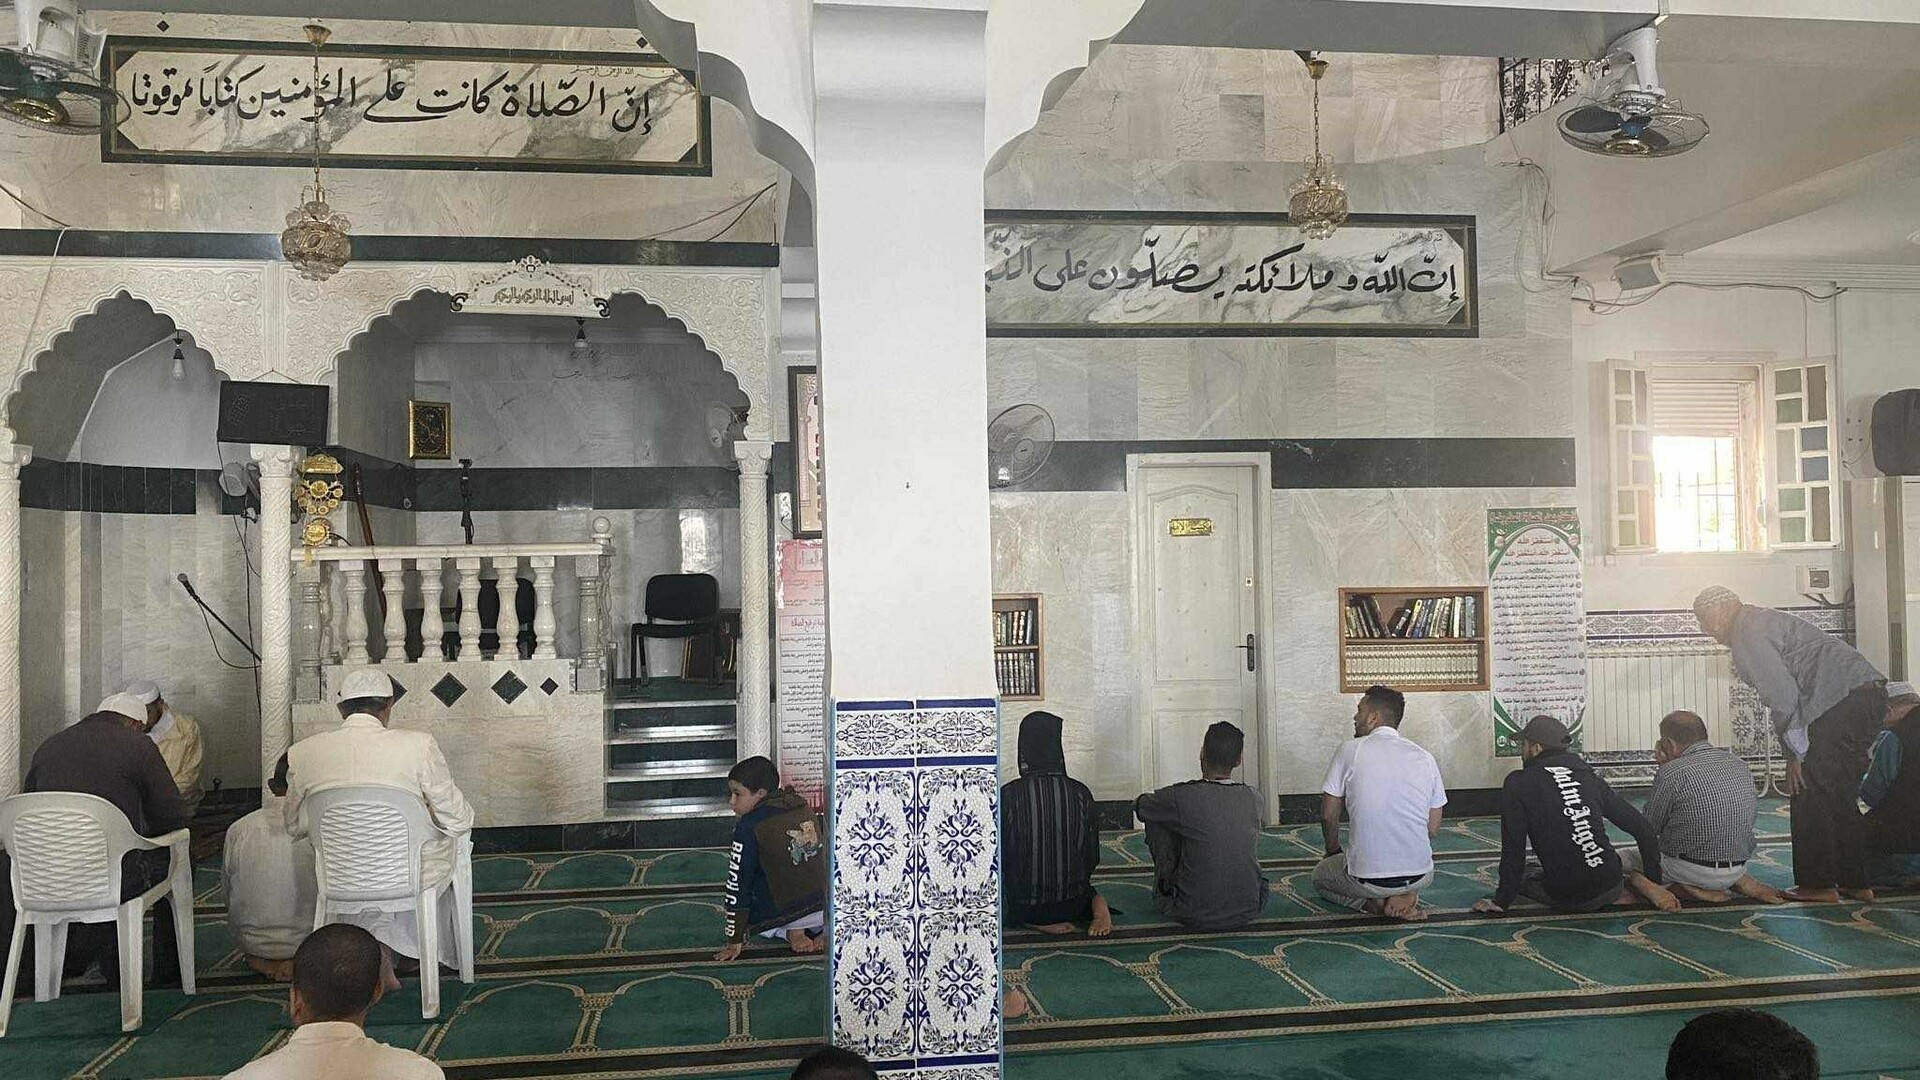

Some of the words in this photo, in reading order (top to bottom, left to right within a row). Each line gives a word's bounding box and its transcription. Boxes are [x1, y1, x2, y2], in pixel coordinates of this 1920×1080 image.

[236, 67, 356, 120] المؤمنين
[415, 70, 510, 114] كانت
[1563, 805, 1604, 868] Angels
